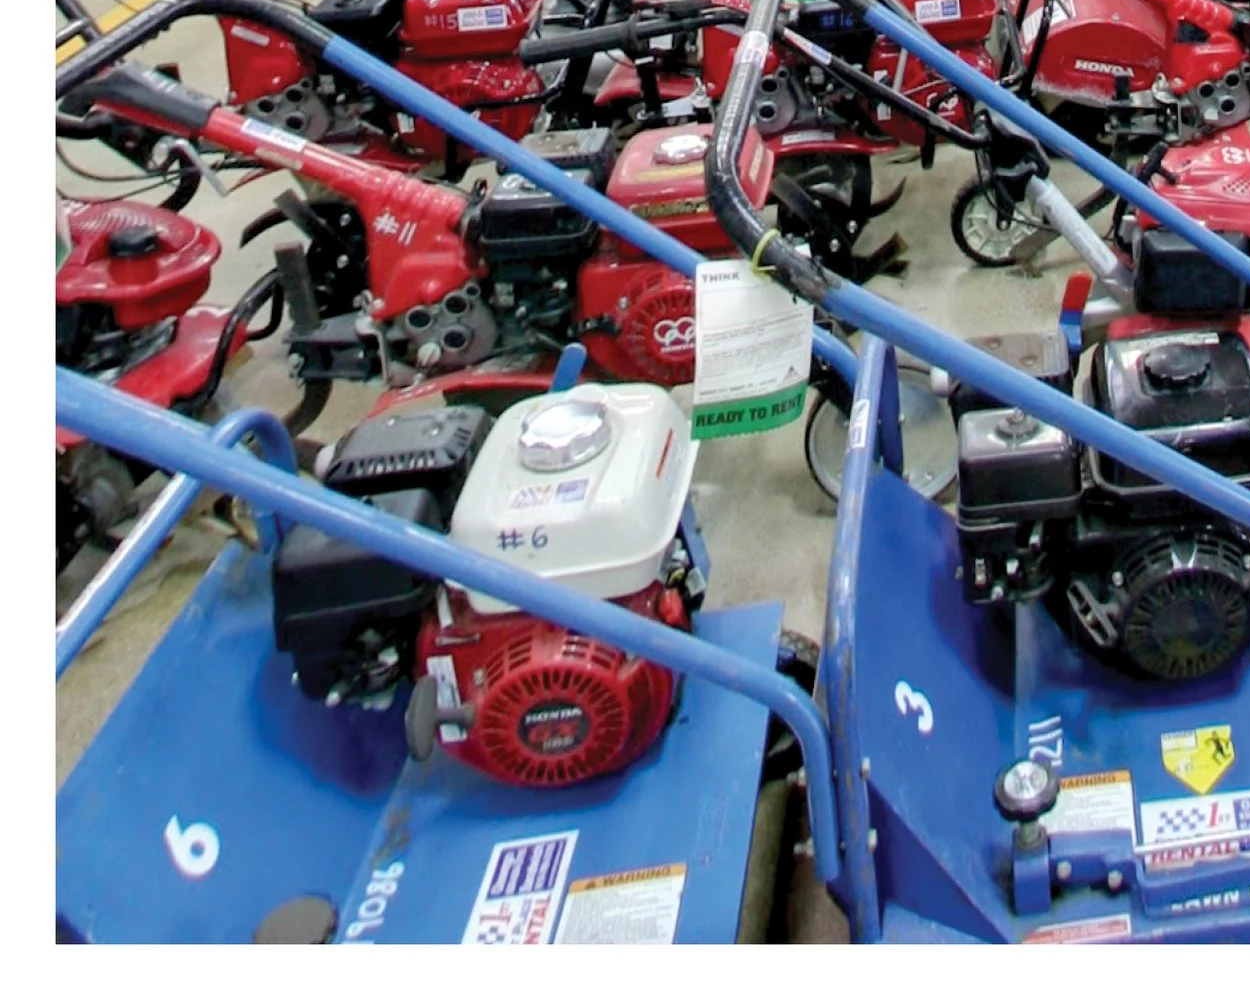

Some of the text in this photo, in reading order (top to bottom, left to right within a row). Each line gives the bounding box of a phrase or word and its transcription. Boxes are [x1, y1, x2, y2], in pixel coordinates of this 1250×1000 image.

[1074, 59, 1135, 77] HONDA
[702, 271, 741, 284] THINK
[696, 394, 802, 427] READY TO RENT
[895, 680, 933, 733] 3
[164, 813, 219, 877] 6
[602, 866, 672, 887] WARNING
